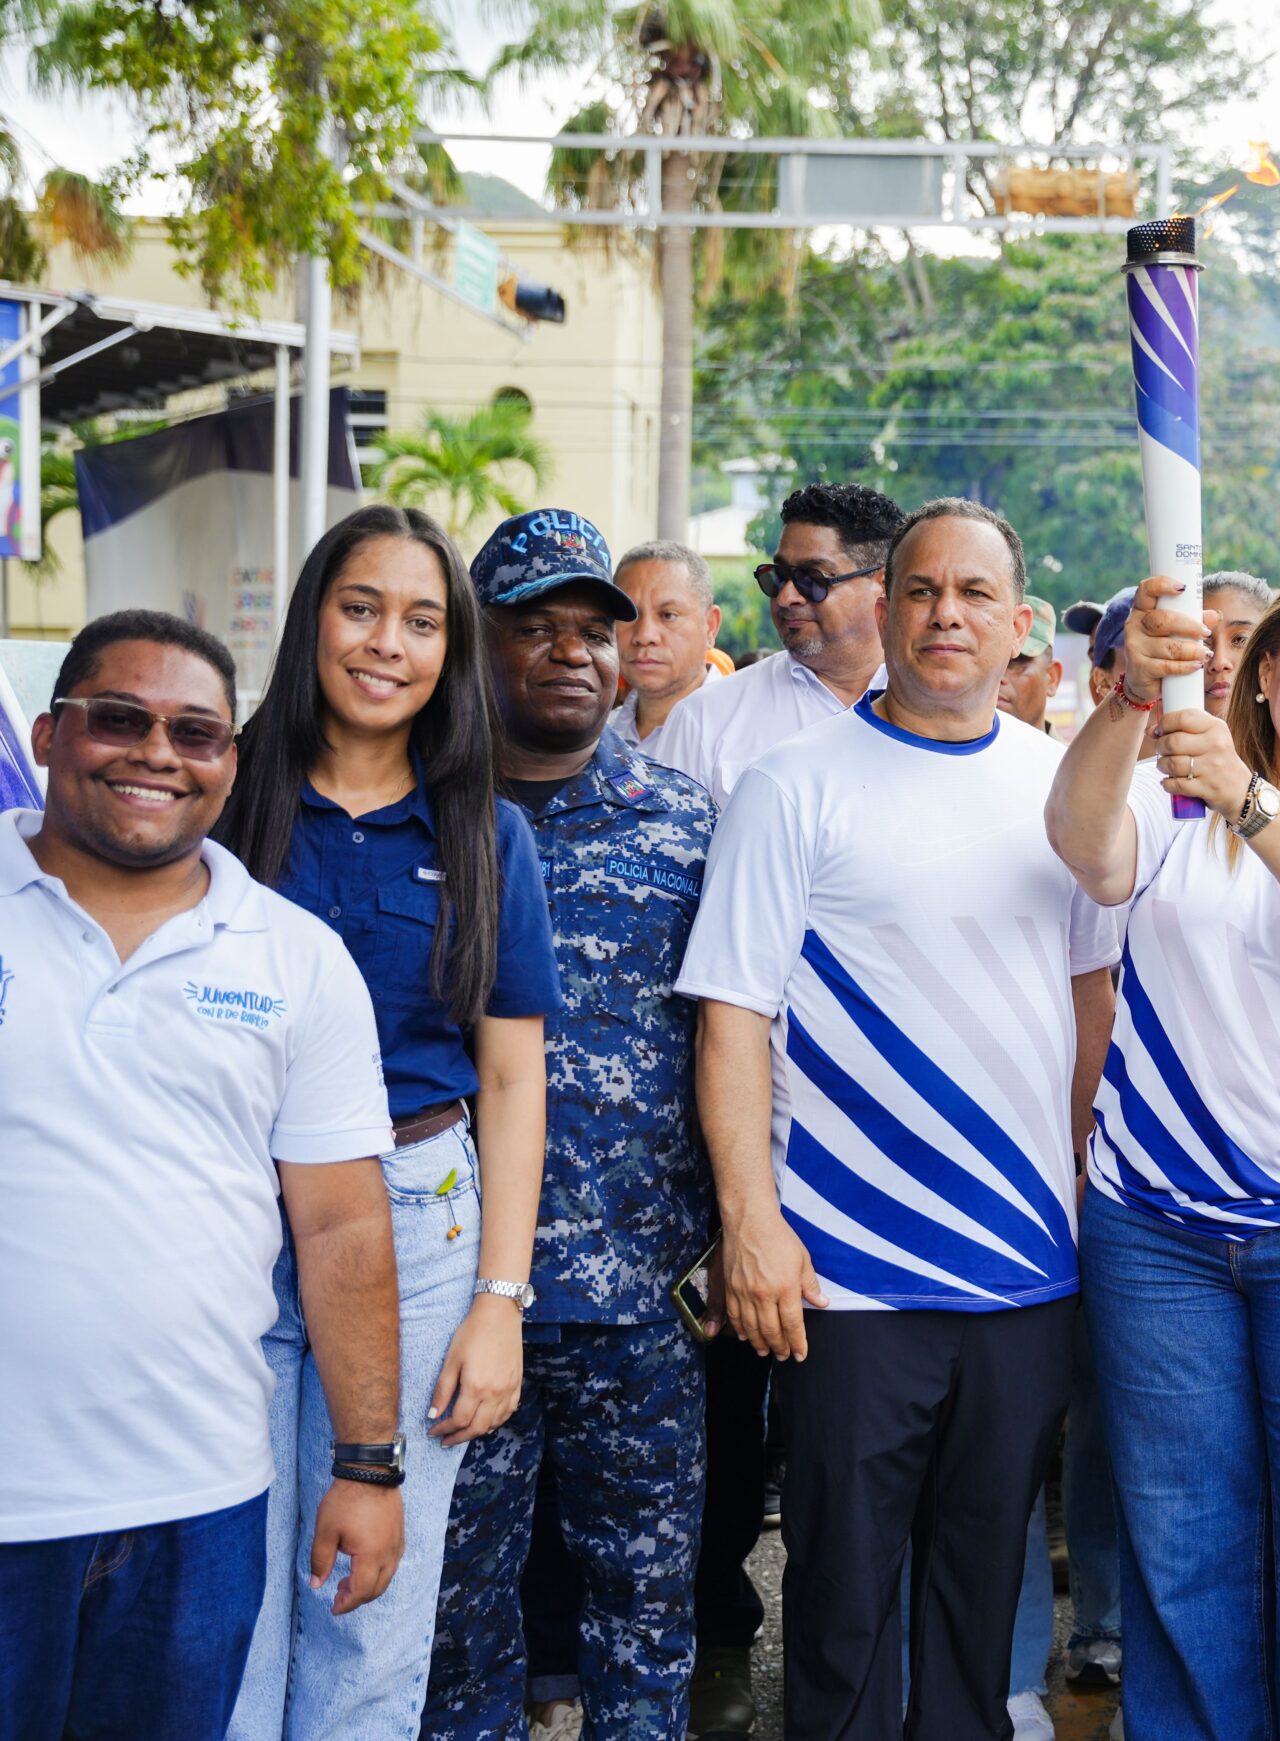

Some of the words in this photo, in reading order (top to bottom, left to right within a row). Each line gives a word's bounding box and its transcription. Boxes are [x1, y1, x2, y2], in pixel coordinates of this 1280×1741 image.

[510, 511, 610, 570] POLICIA
[609, 860, 649, 881] POLICIA
[653, 868, 700, 897] NACIONAL
